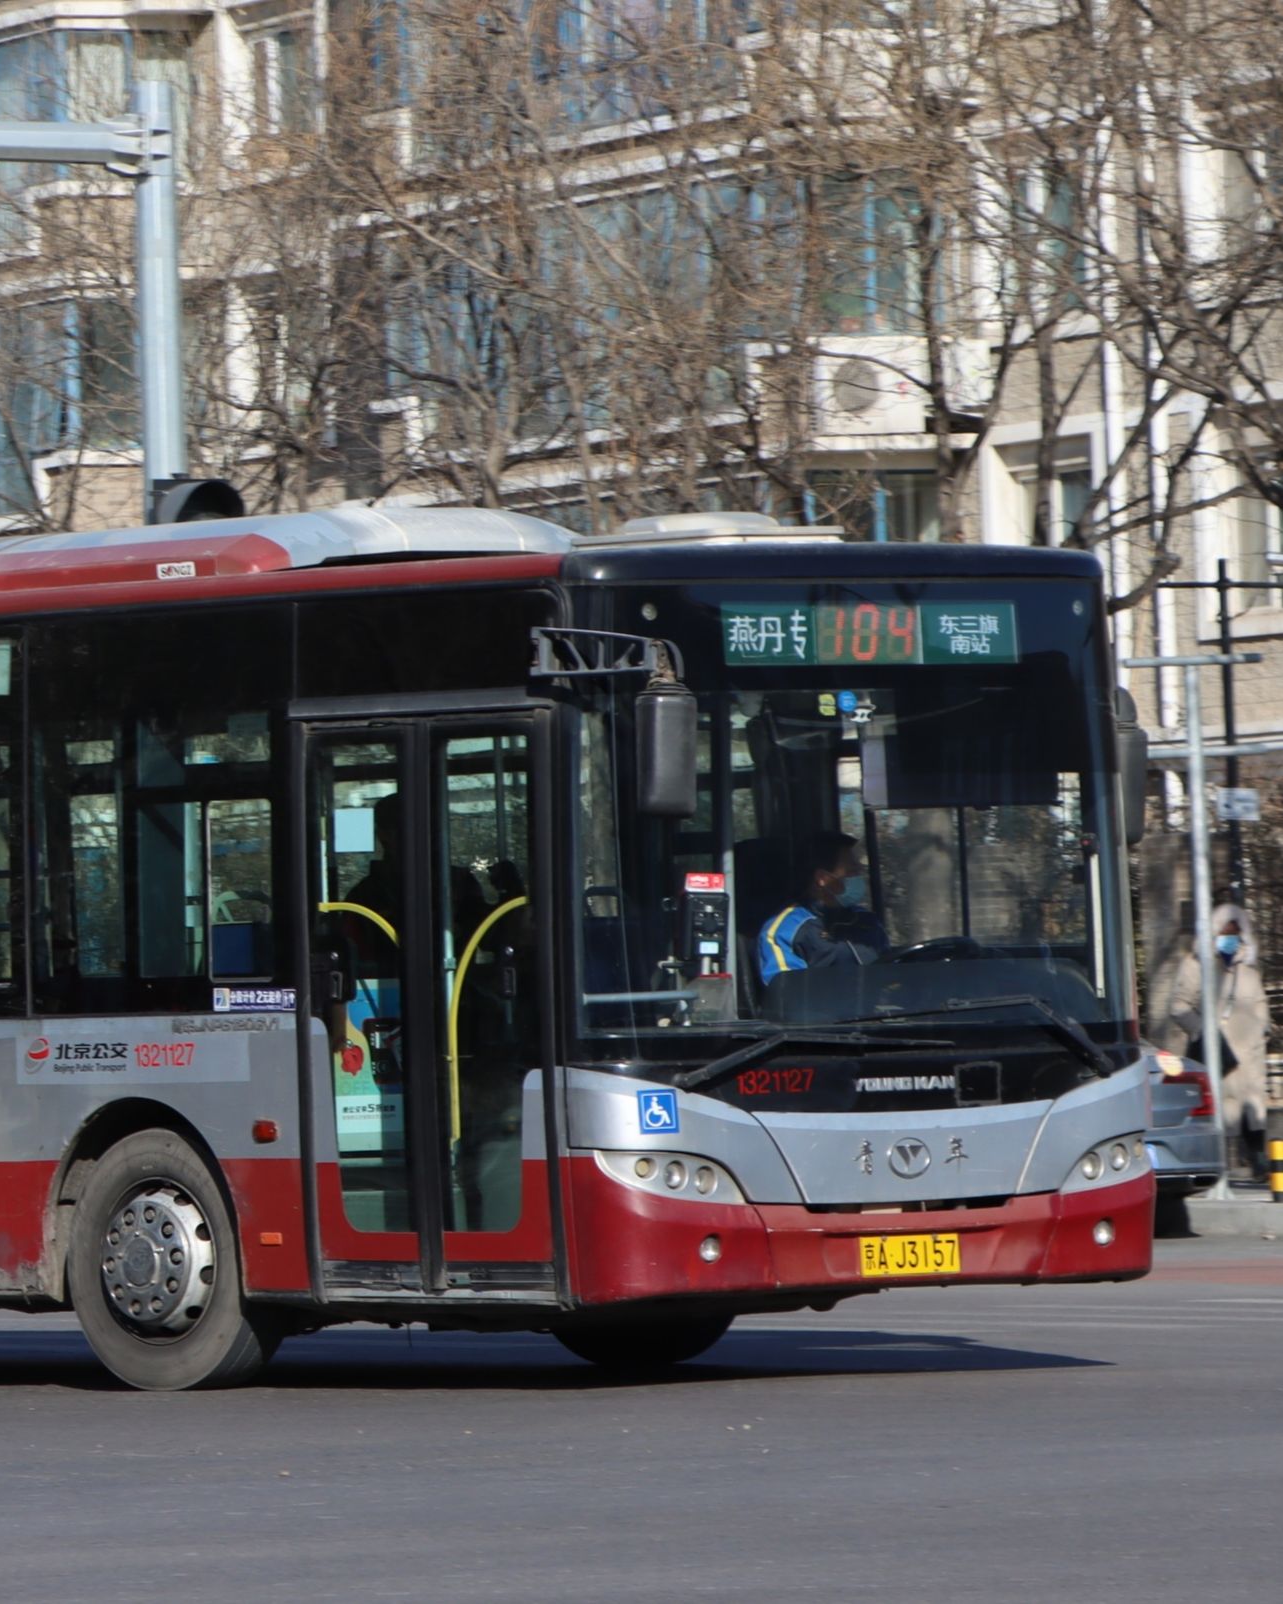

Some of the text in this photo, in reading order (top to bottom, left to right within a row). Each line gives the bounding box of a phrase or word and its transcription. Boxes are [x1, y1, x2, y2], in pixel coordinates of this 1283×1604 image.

[834, 603, 914, 661] 104
[938, 614, 1000, 635] 东三旗
[950, 635, 991, 655] 南站
[55, 1043, 129, 1060] 北京公交
[135, 1043, 195, 1067] 1321127
[53, 1062, 127, 1075] Beijing Public Transport
[737, 1069, 815, 1095] 1321127
